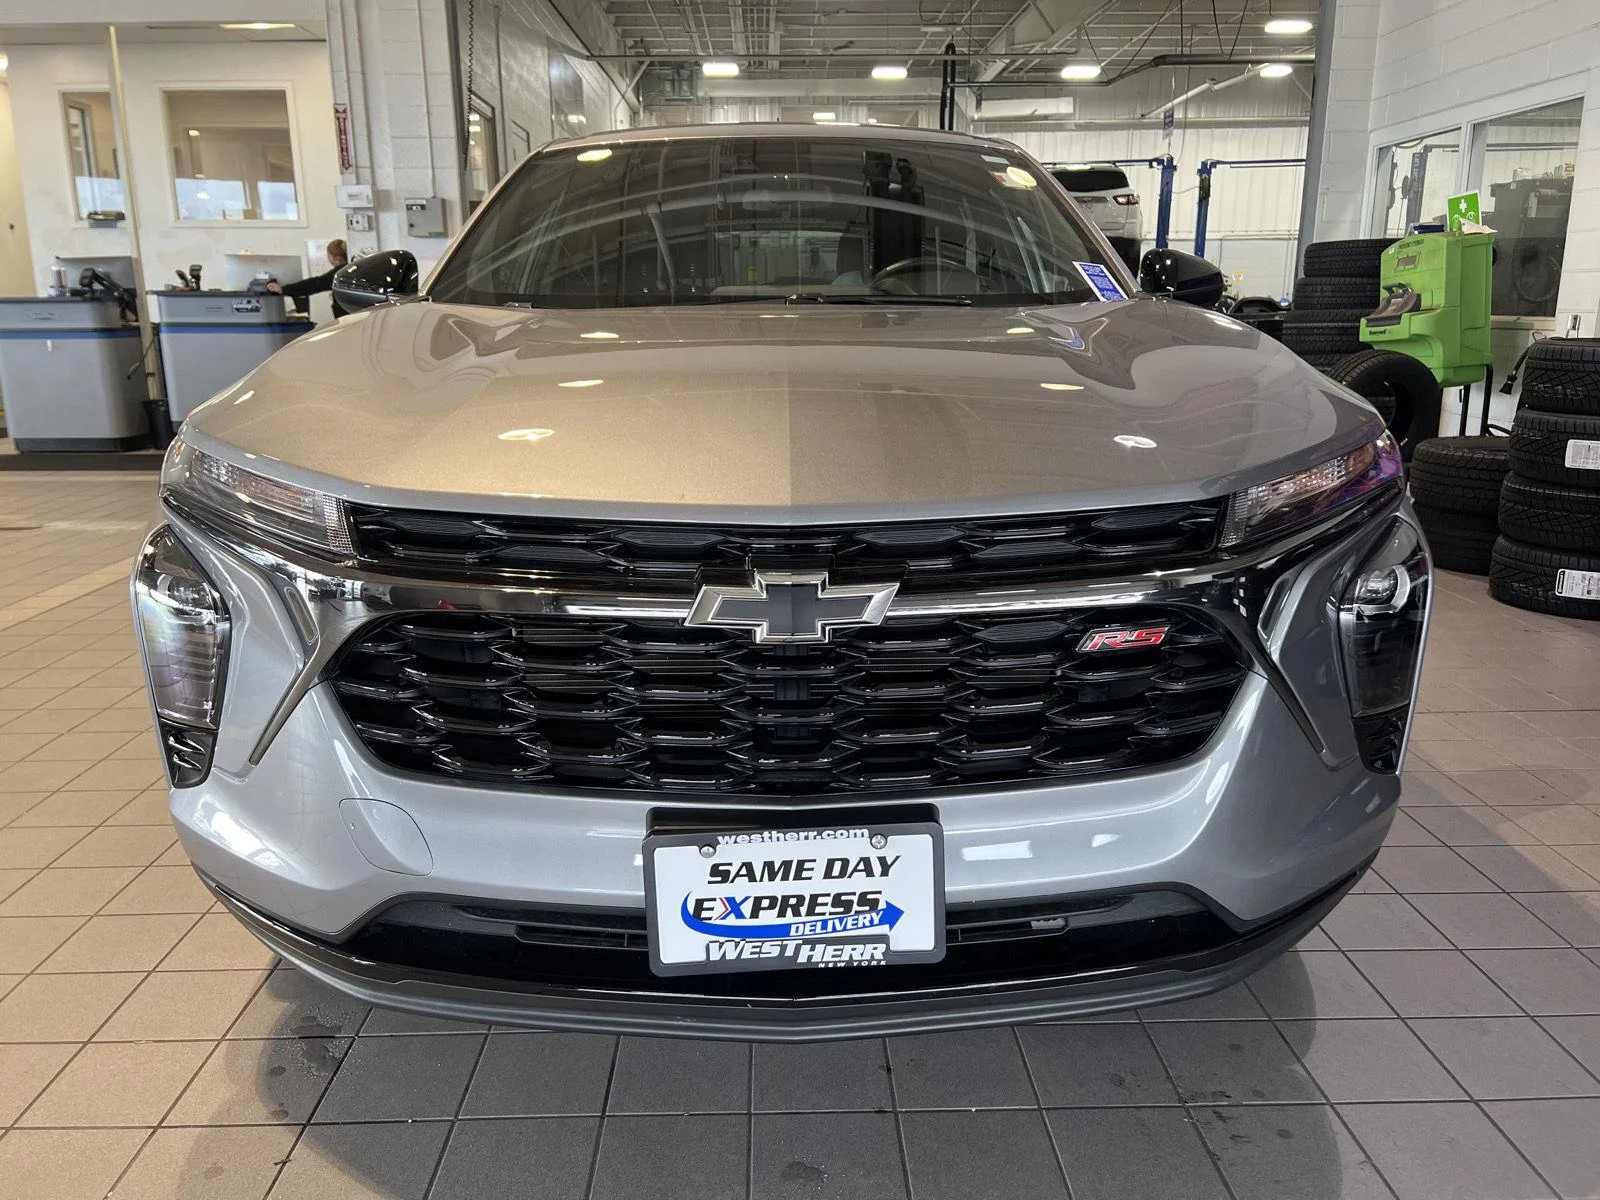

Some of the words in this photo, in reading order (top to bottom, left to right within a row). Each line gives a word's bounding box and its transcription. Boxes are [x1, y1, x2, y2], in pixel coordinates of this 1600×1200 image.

[1087, 627, 1168, 650] RS
[717, 827, 869, 845] westherr.com
[707, 858, 816, 885] SAME
[823, 855, 902, 880] DAY
[692, 890, 882, 921] EXPRESS
[789, 910, 884, 937] DELIVERY
[853, 959, 888, 967] YORK
